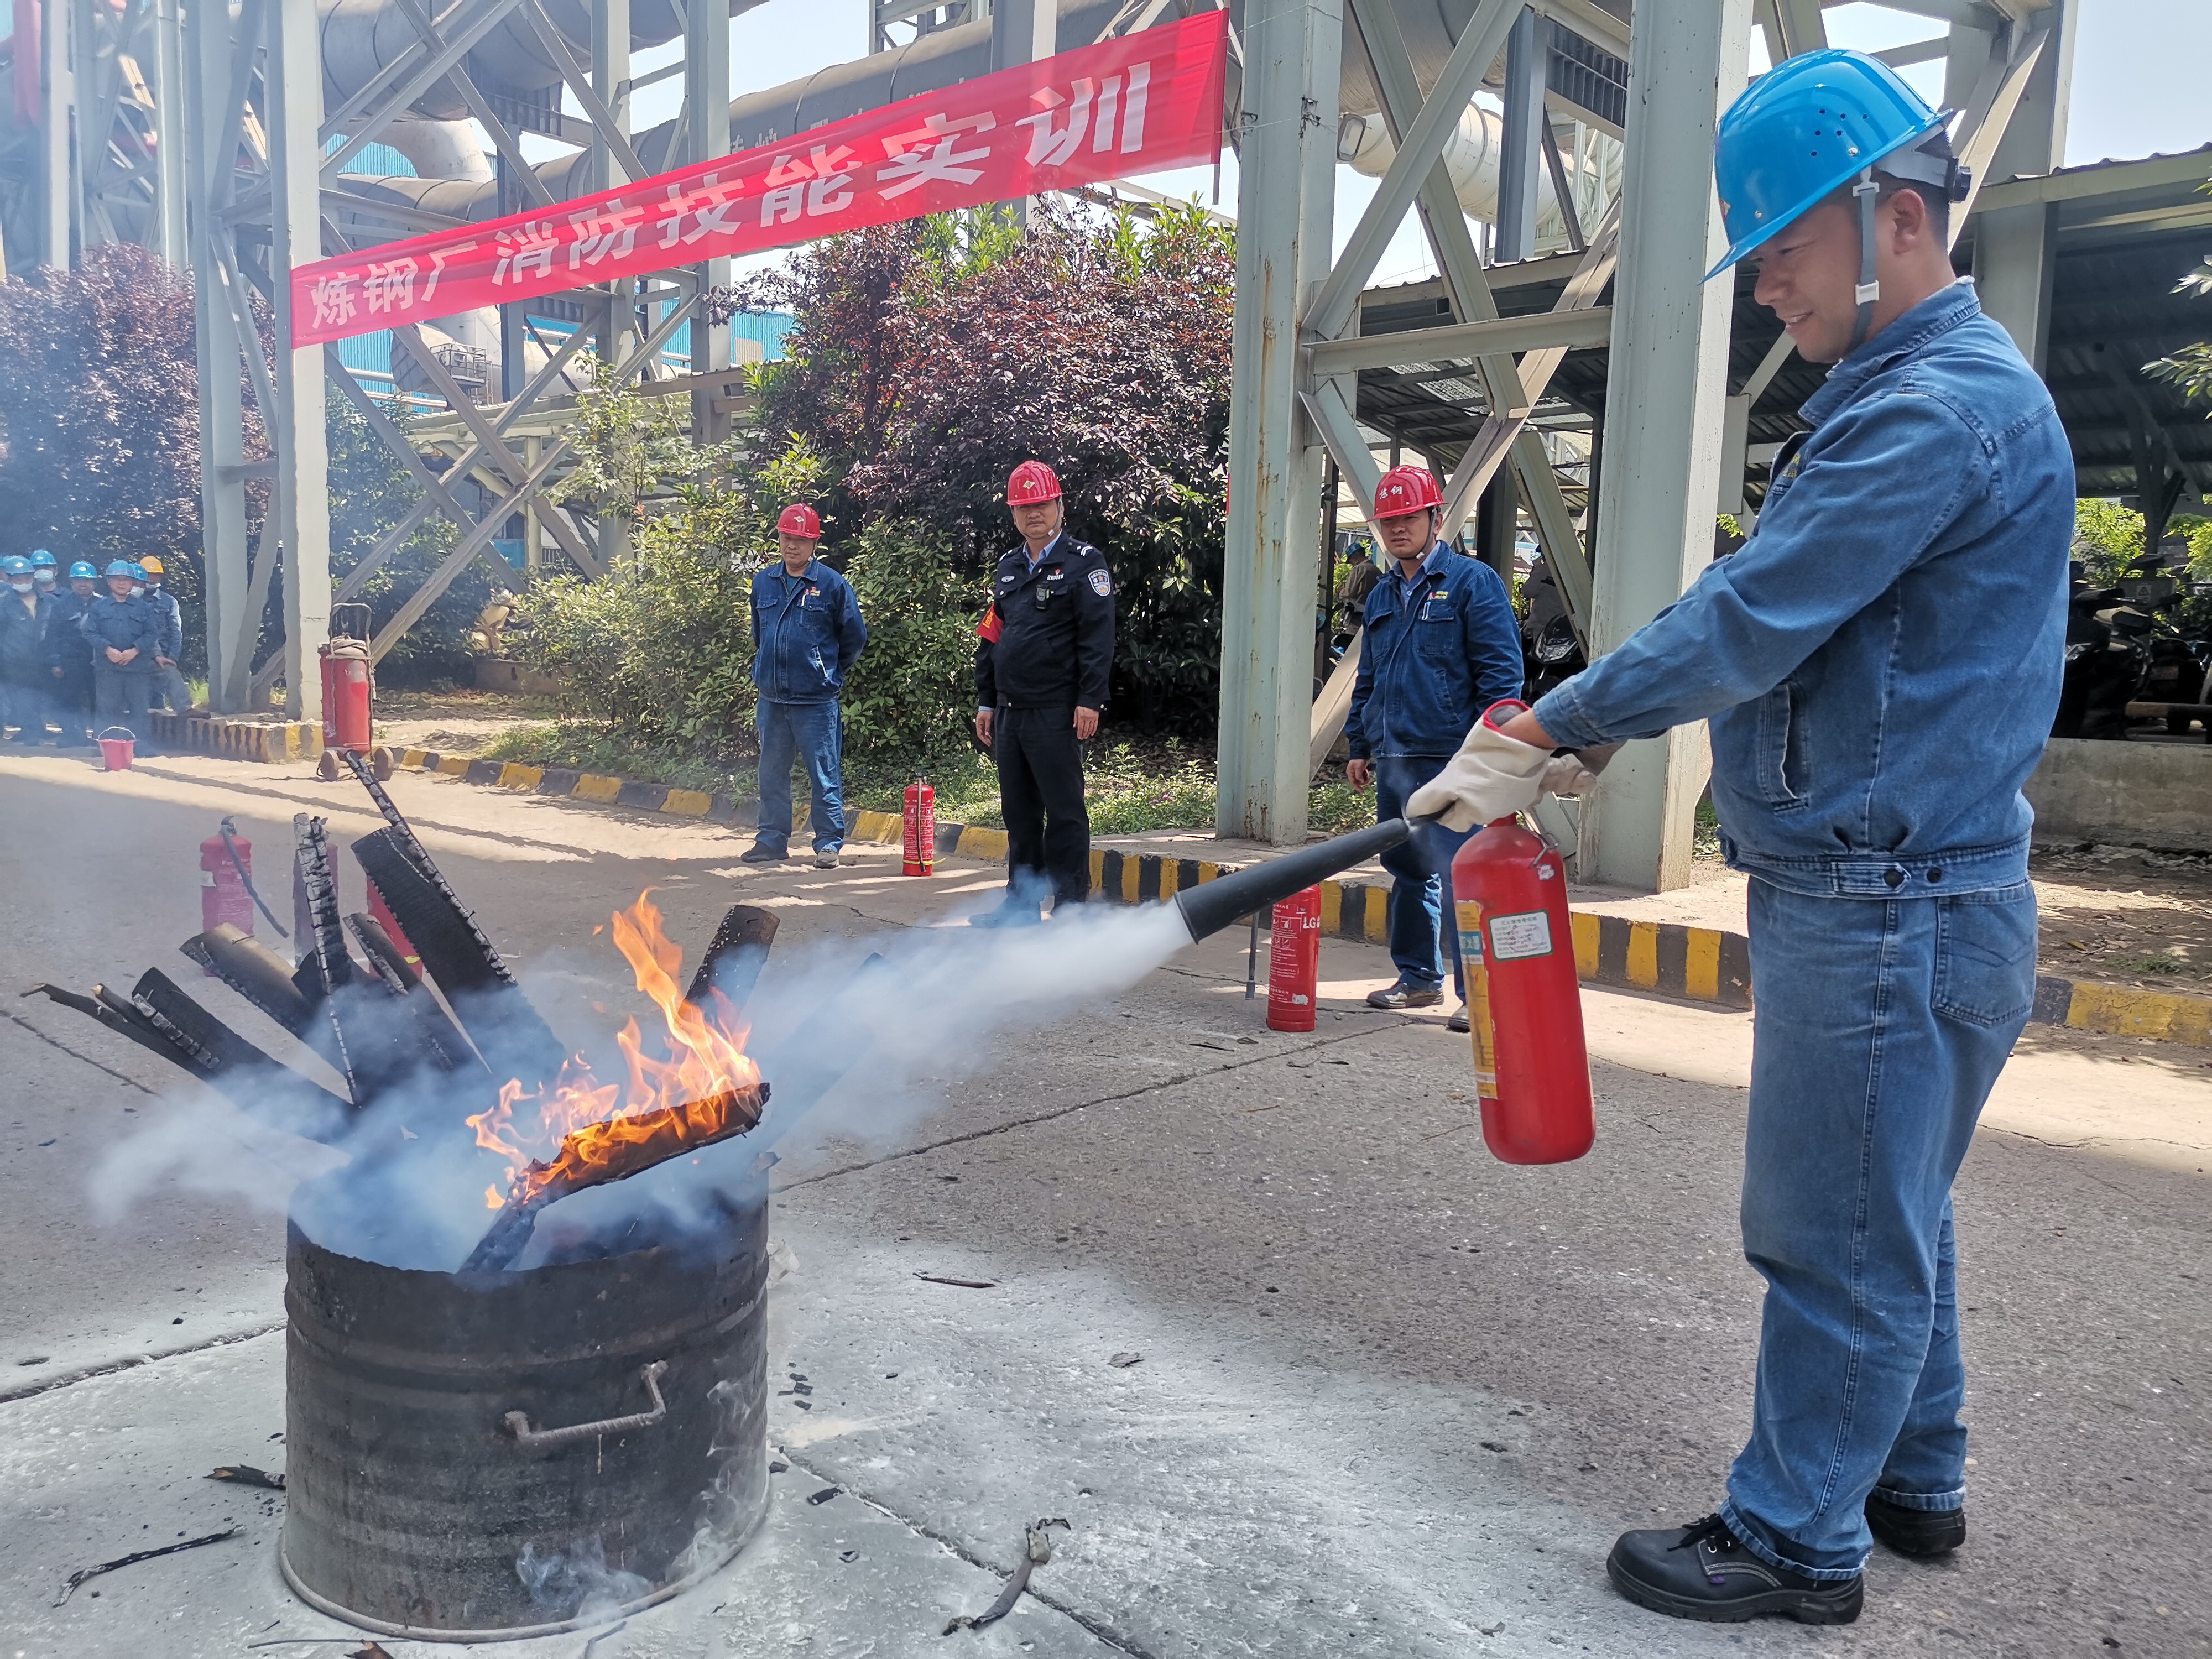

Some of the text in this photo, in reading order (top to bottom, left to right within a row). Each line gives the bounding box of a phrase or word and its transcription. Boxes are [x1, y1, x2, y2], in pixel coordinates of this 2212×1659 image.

[311, 61, 1151, 330] 炼钢厂消防技能实训
